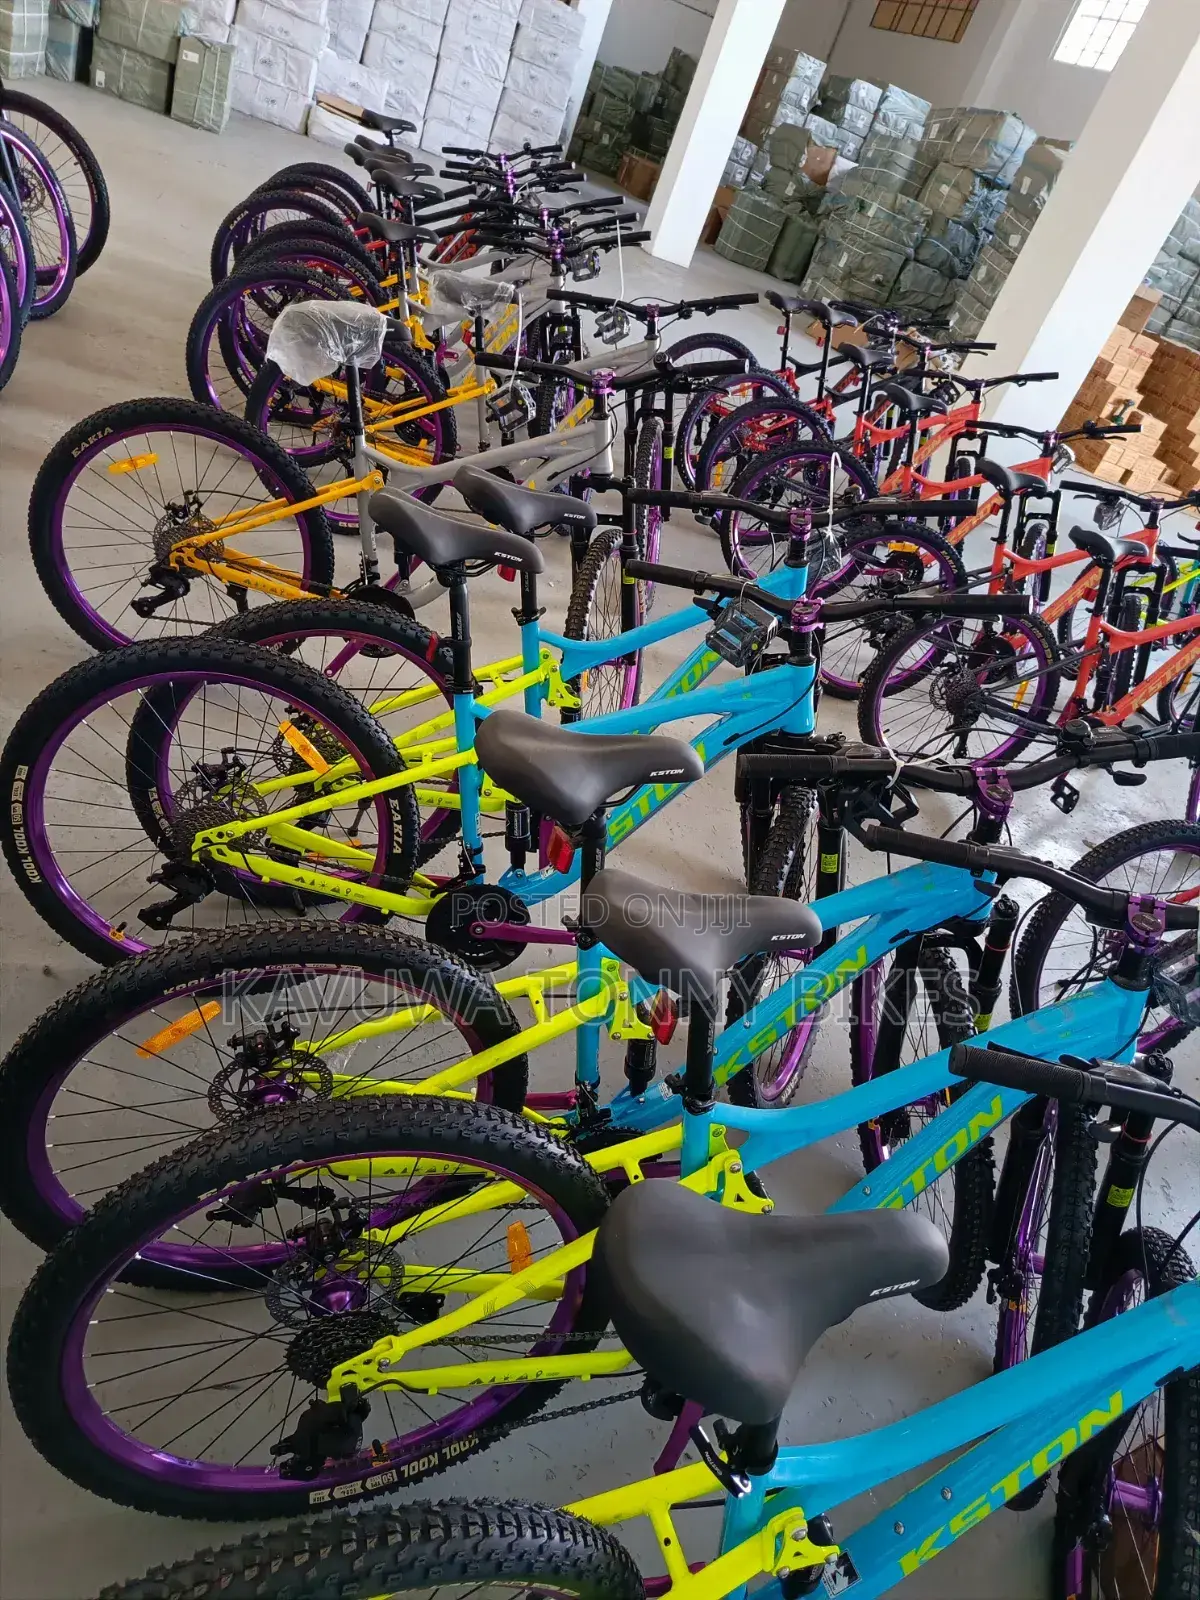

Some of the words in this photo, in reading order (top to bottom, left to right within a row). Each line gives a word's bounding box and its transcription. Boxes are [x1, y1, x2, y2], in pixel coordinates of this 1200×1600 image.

[563, 512, 586, 520] KSTON
[494, 551, 523, 562] KSTON
[649, 768, 685, 777] KSTON
[13, 828, 30, 854] KOOL
[21, 855, 42, 883] KOOL
[771, 933, 806, 941] KSTON
[713, 945, 867, 1088] KSTON
[869, 1279, 921, 1297] KSTON
[401, 1452, 439, 1478] KOOL
[898, 1390, 1124, 1577] KSTON
